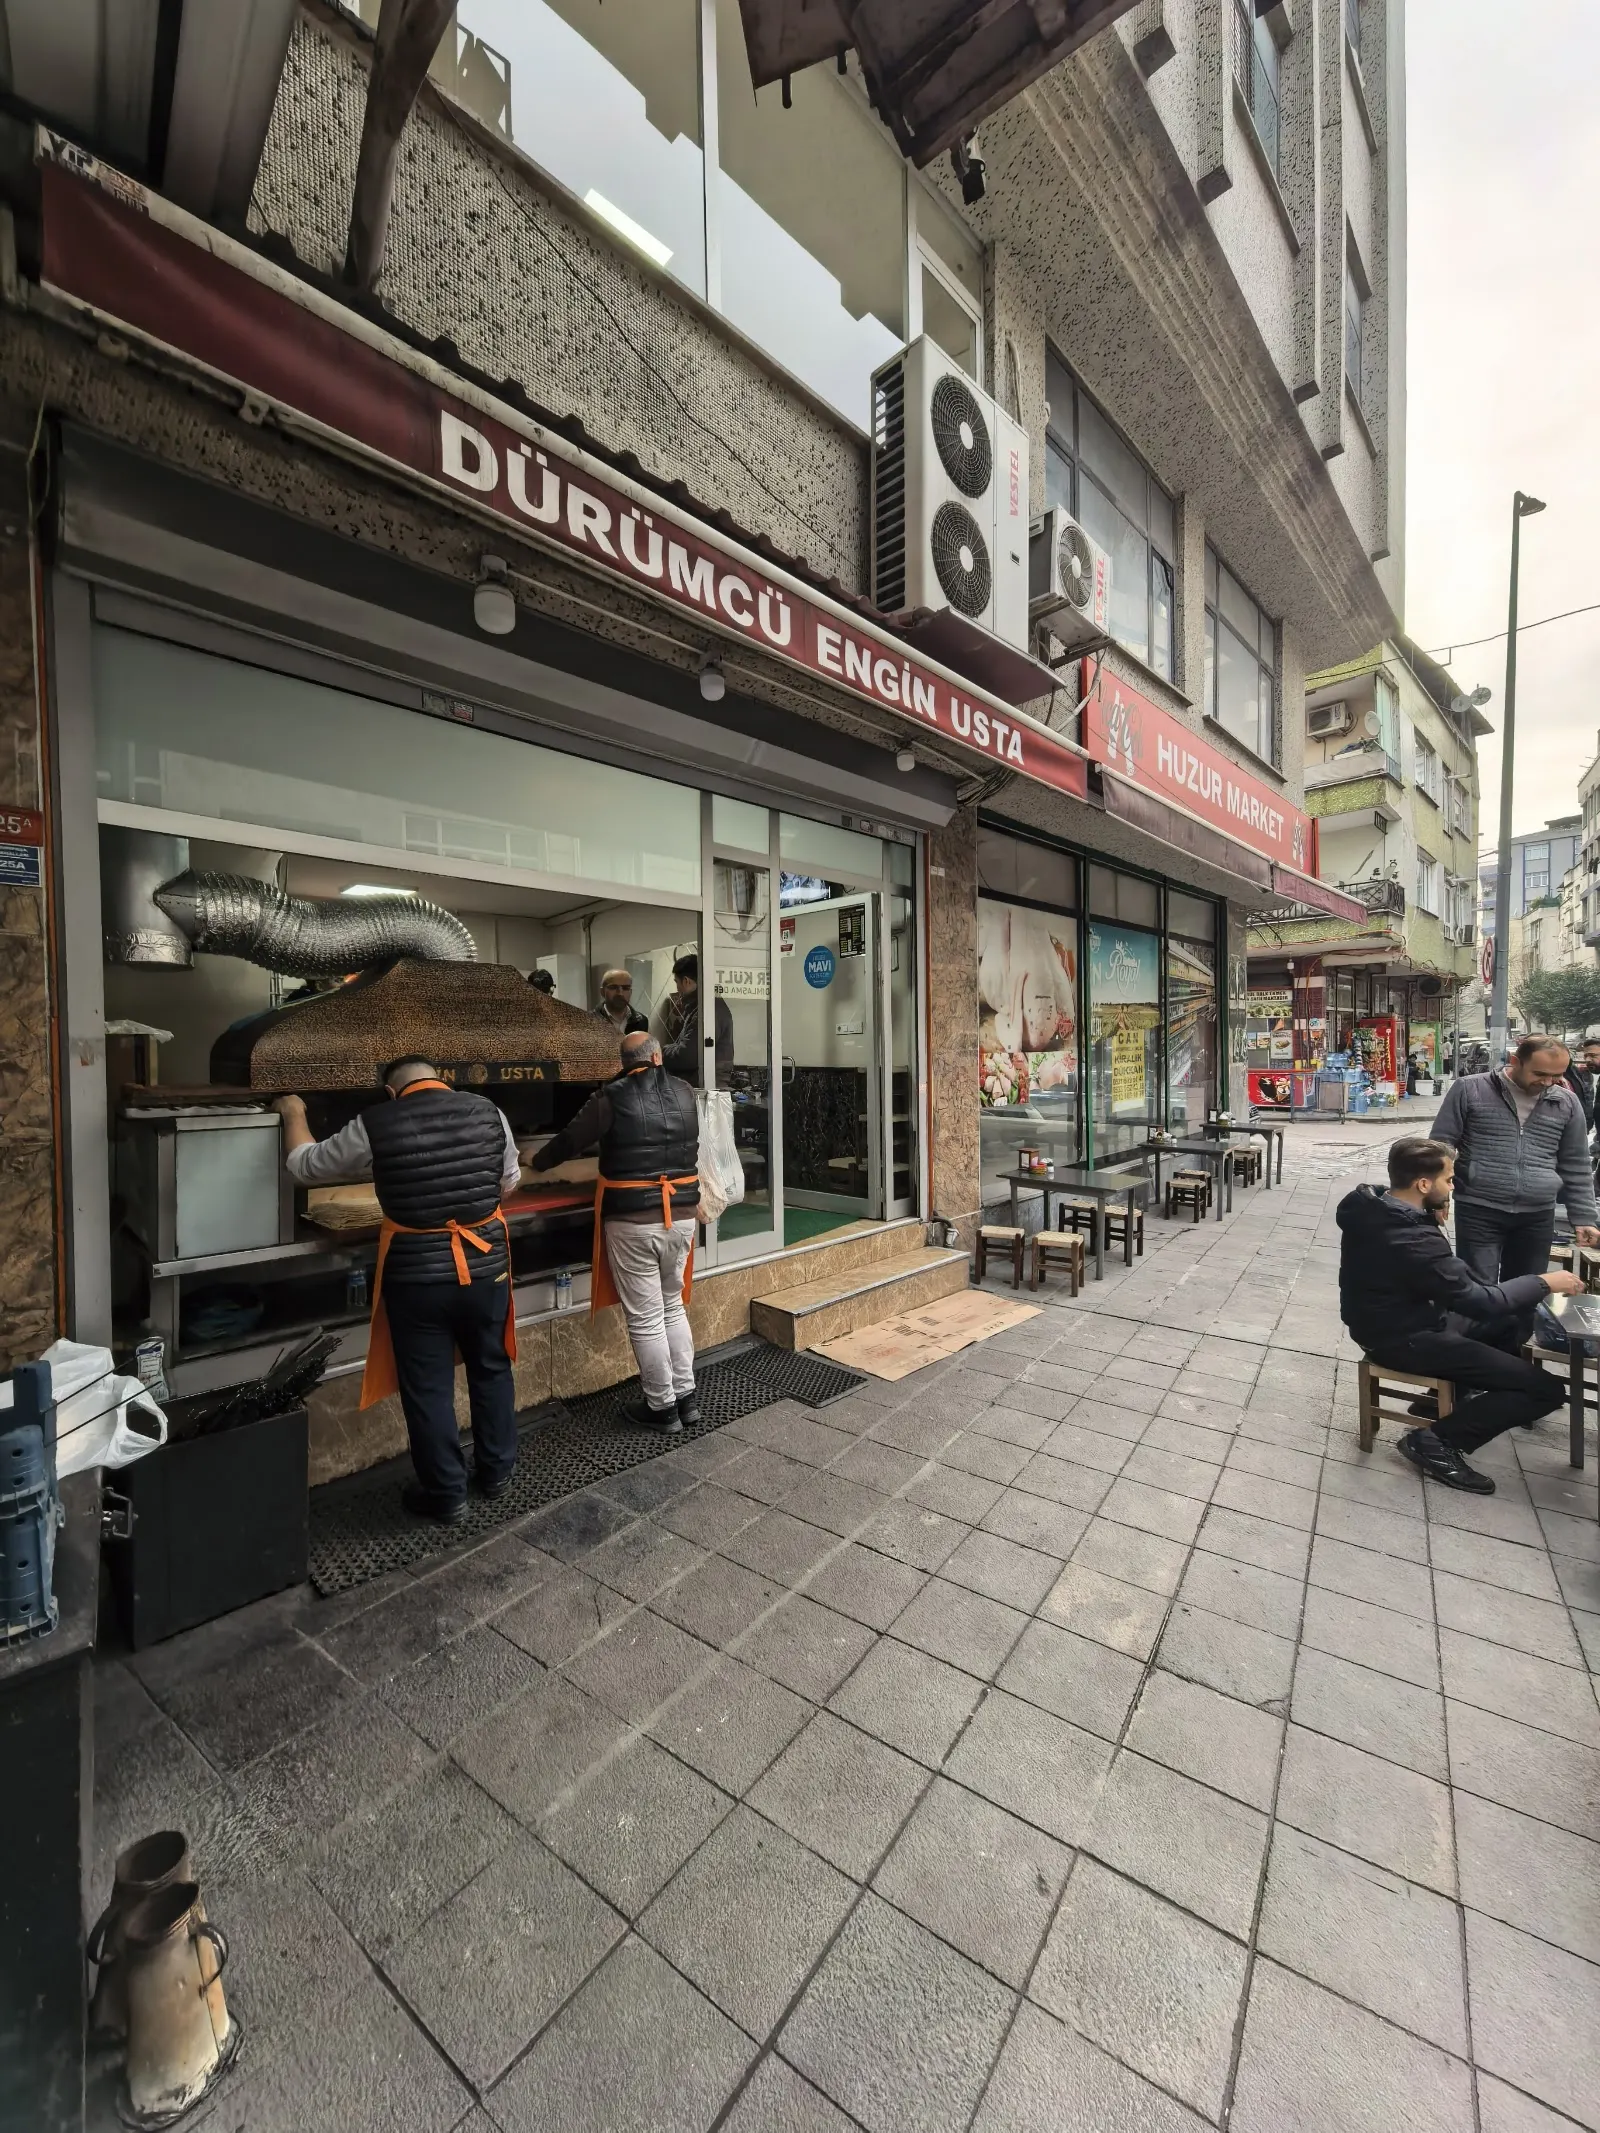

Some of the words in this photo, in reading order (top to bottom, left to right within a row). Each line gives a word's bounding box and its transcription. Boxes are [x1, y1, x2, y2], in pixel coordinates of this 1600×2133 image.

[1010, 449, 1019, 517] VESTEL
[440, 410, 791, 647] DÜRÜMCÜ
[817, 623, 938, 722] ENGİN
[951, 695, 1026, 767] USTA
[1096, 558, 1105, 621] VESTEL
[1157, 733, 1223, 808] HUZUR
[1227, 780, 1284, 842] MARKET
[808, 959, 832, 974] MAVİ
[1118, 1032, 1139, 1045] CAN
[500, 1067, 545, 1080] USTA
